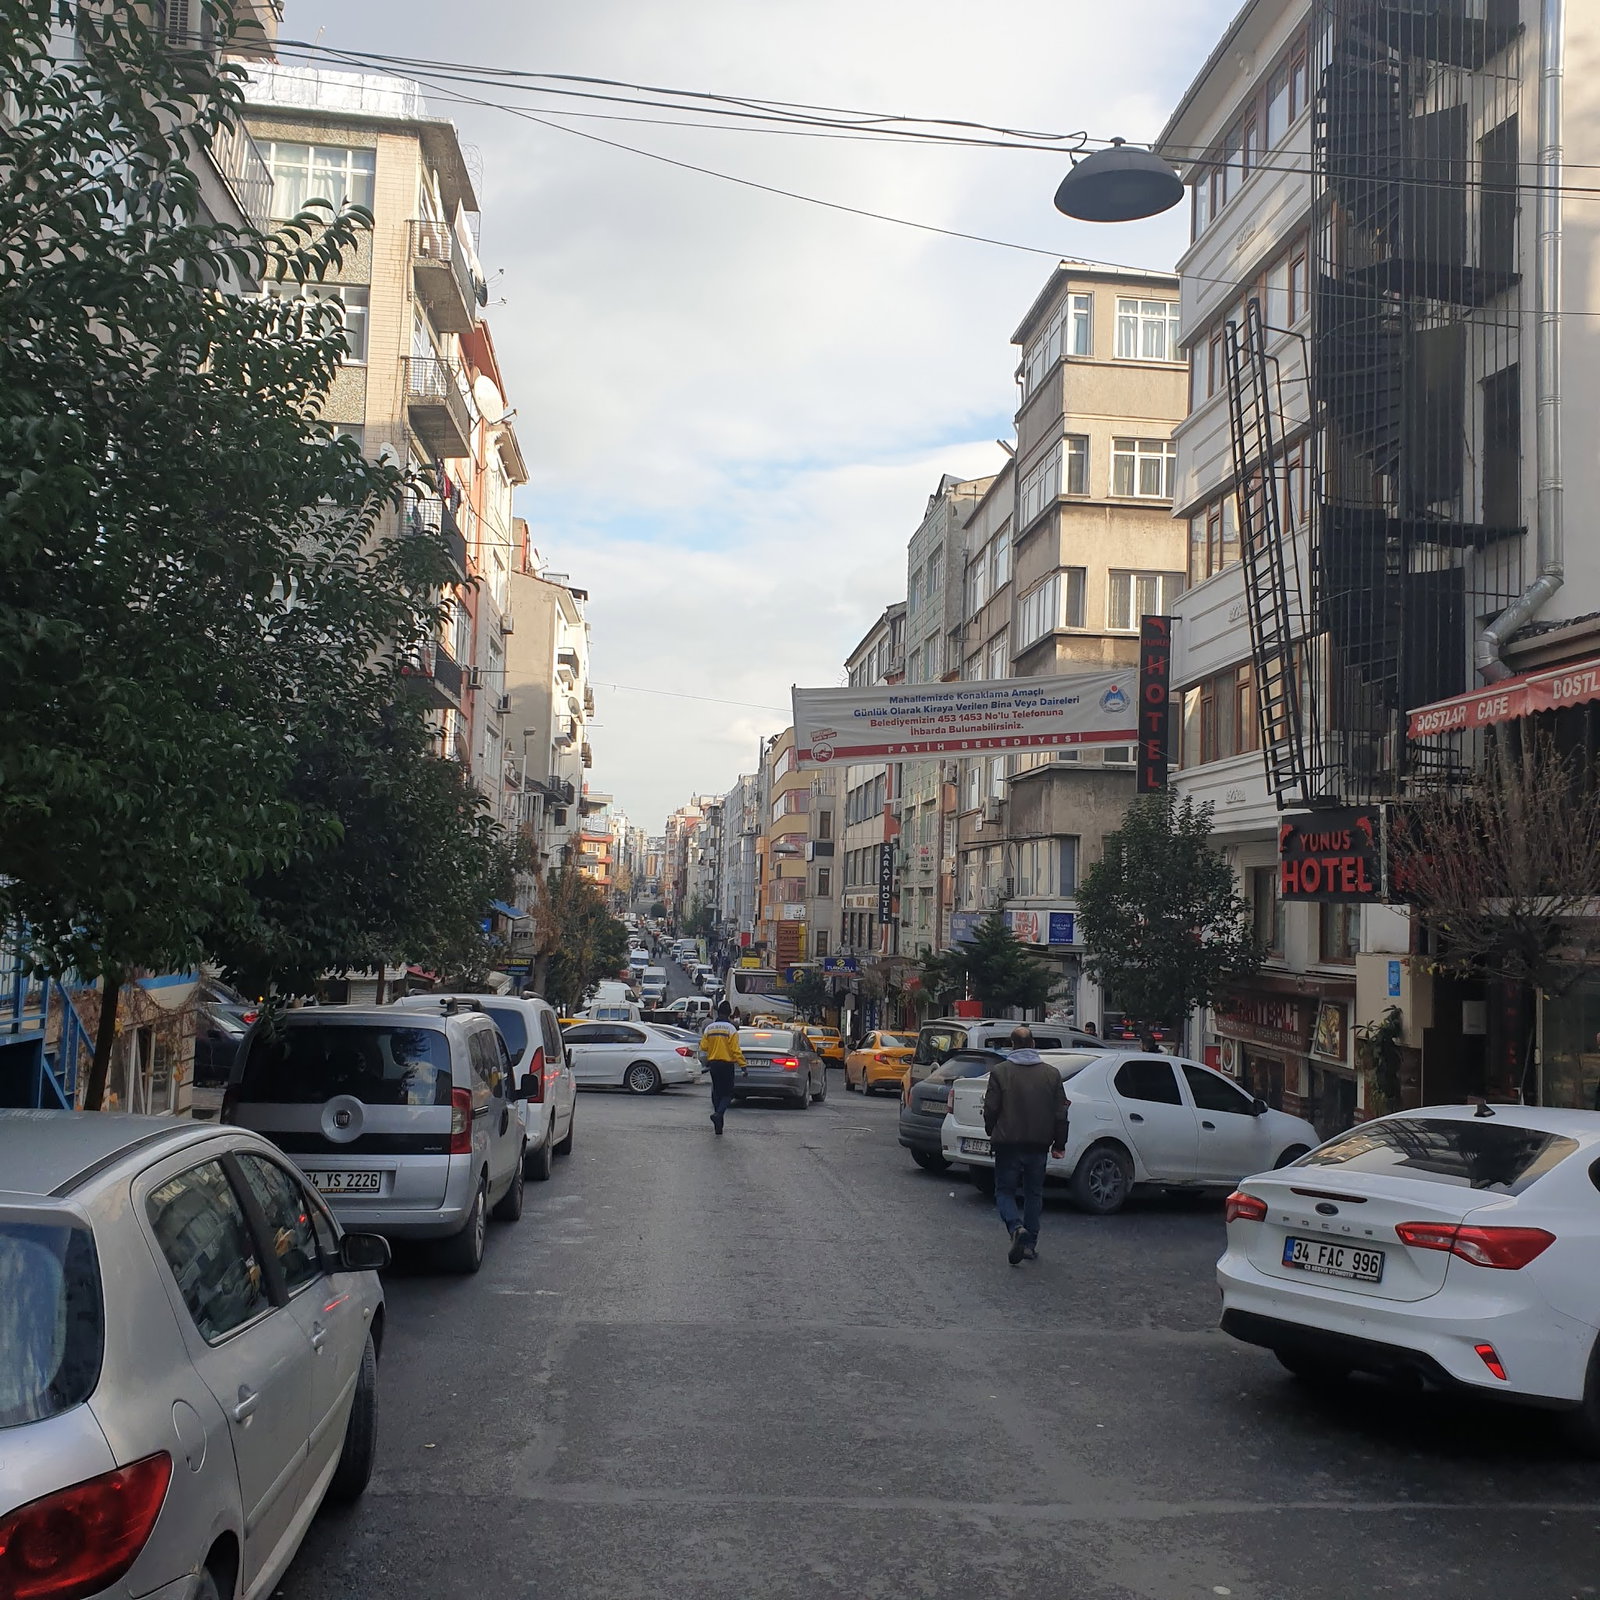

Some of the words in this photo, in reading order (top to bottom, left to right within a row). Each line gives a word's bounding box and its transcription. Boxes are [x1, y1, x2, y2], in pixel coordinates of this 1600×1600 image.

[853, 707, 888, 717] Günlük
[890, 706, 921, 715] Olarak
[923, 704, 953, 714] Kiraya
[955, 702, 988, 711] Verilen
[991, 700, 1012, 709] Bina
[1014, 698, 1037, 708] Veya
[1040, 695, 1080, 706] Daireleri
[889, 692, 954, 704] Mahallemizde
[956, 690, 1009, 701] Konaklama
[1012, 687, 1044, 698] Amaçlı
[870, 716, 935, 727] Belediyemizin
[937, 714, 957, 722] 453
[959, 713, 982, 721] 1453
[1012, 709, 1064, 718] Telefonuna
[1145, 655, 1165, 788] HOTEL
[1417, 705, 1467, 732] DOSTLAR
[1477, 696, 1509, 721] CAFE
[910, 726, 946, 736] İhbarda
[948, 722, 1024, 734] Bulunabilirsiniz.
[888, 742, 945, 754] FATİH
[961, 732, 1082, 749] BELEDİYESİ
[1300, 829, 1350, 851] YUNUS
[882, 845, 891, 881] SARAY
[1281, 856, 1373, 893] HOTEL
[882, 885, 891, 921] HOTEL
[327, 1173, 341, 1187] YS
[346, 1173, 378, 1187] 2226
[1293, 1242, 1309, 1262] 34
[1318, 1246, 1344, 1267] FAC
[1352, 1252, 1379, 1274] 996
